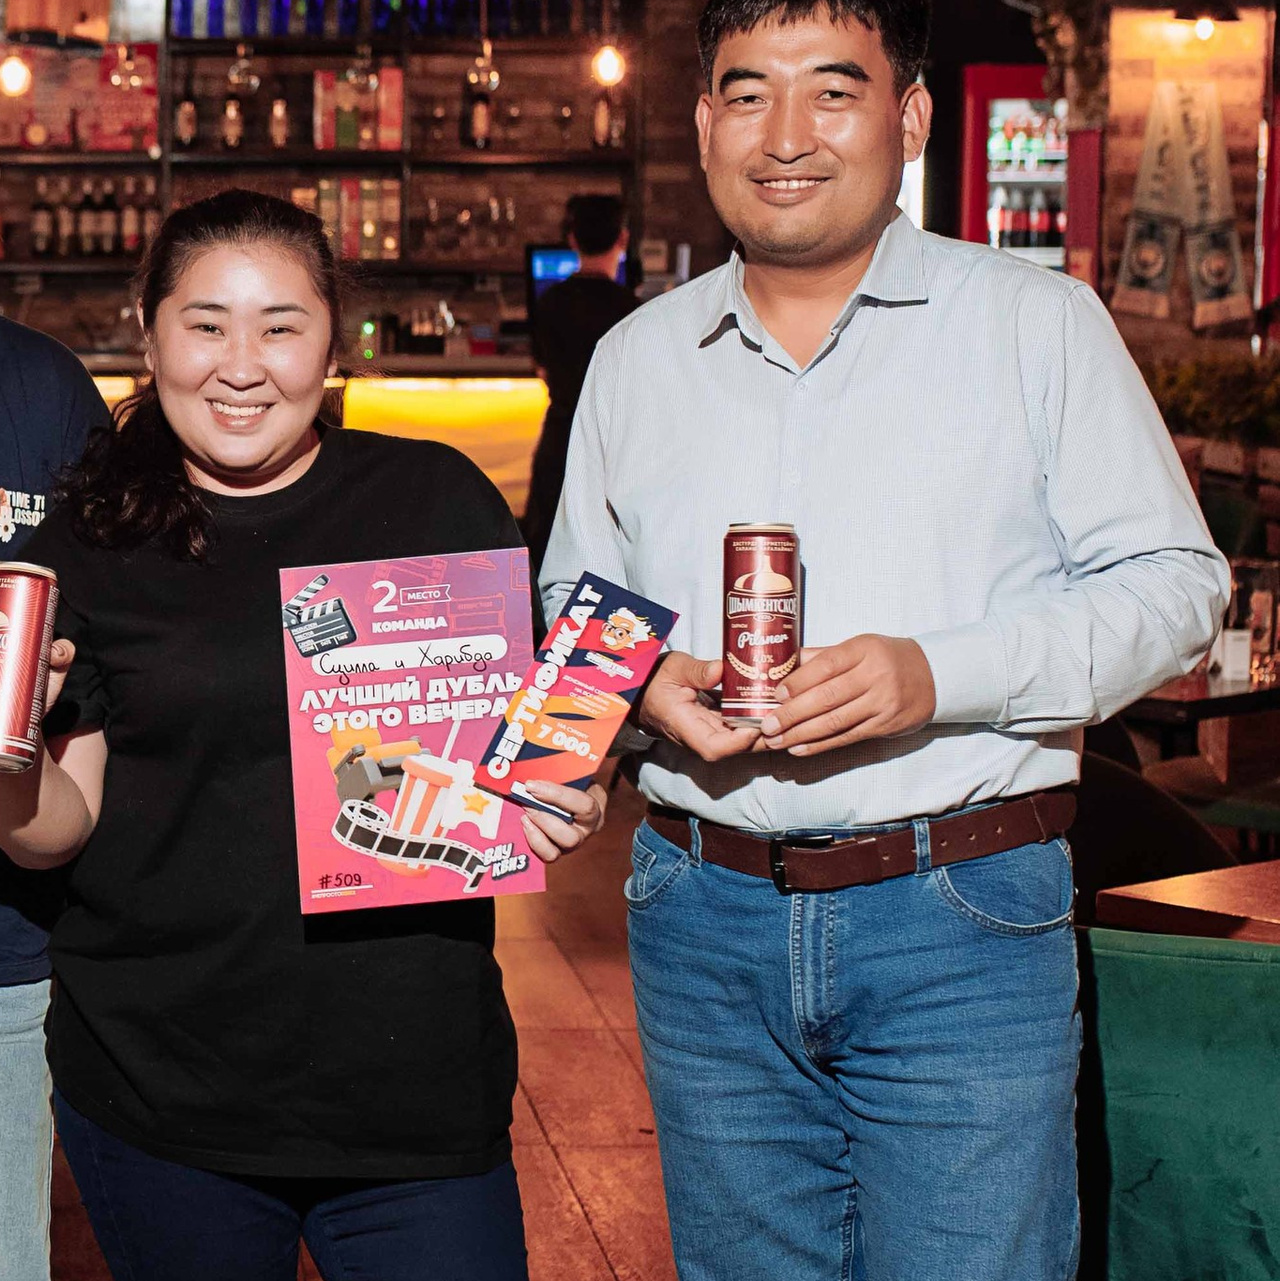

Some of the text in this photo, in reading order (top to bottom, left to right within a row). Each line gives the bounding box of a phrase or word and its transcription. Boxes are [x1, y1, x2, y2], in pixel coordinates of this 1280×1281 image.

[372, 580, 441, 613] 2 МЕСТО
[372, 616, 448, 634] КОМАНДА
[738, 629, 789, 649] Pilsner
[395, 659, 405, 669] и
[418, 642, 493, 672] Харибда
[300, 672, 524, 712] ЛУЧШИЙ ДУБЛЬ
[487, 583, 604, 780] СЕРТИФИКАТ
[313, 697, 510, 734] ЭТОГО ВЕЧЕРА
[536, 724, 554, 740] 7
[319, 873, 361, 889] #509
